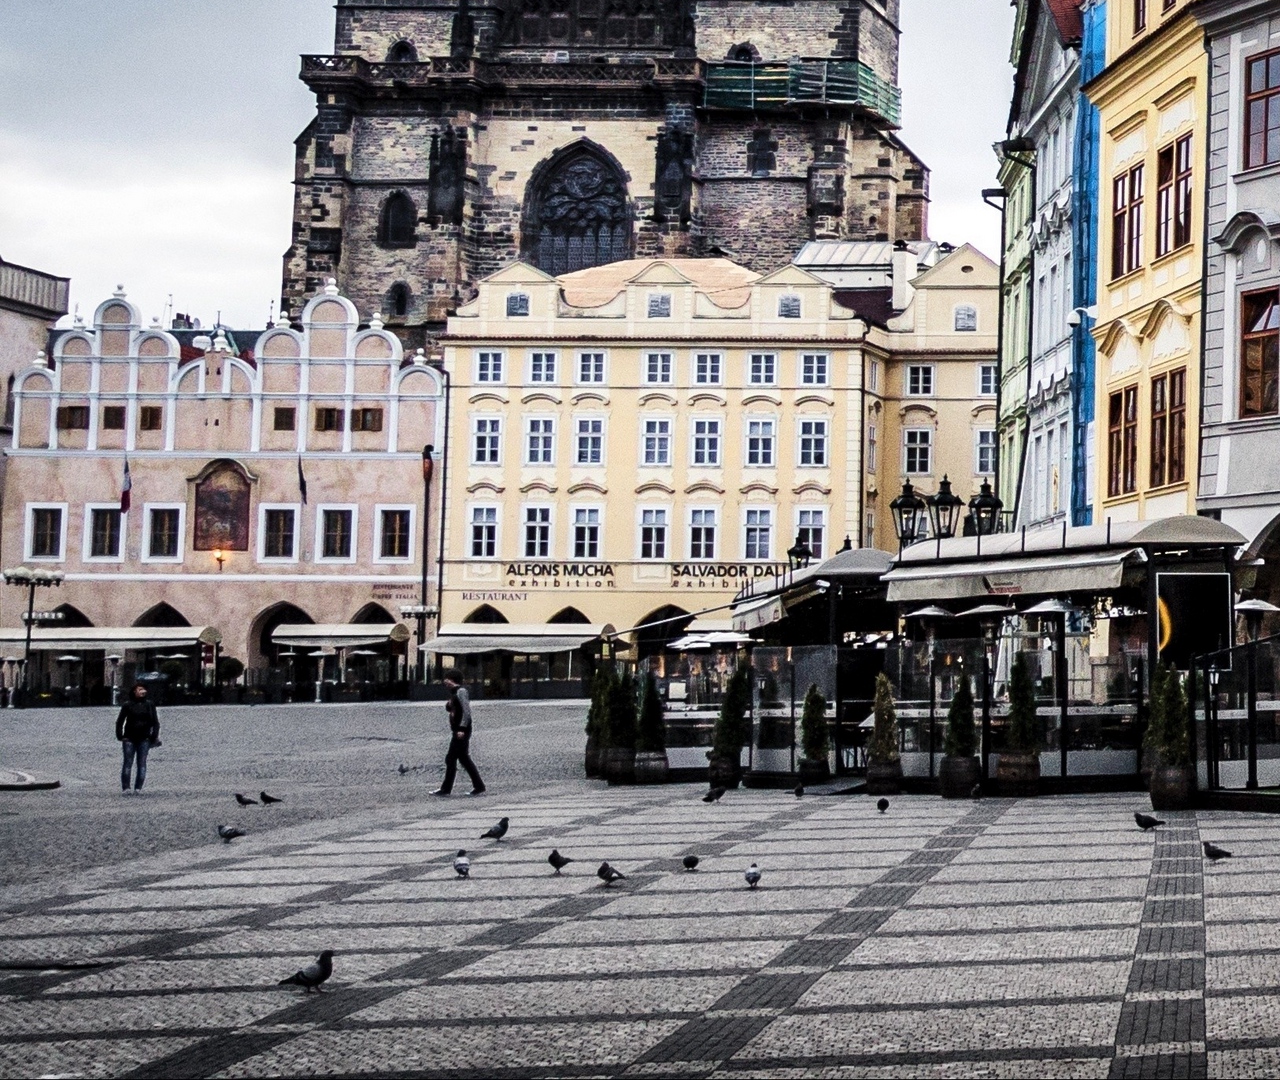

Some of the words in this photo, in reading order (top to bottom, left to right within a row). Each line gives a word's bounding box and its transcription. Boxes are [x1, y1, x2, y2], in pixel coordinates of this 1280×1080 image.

[506, 563, 560, 576] ALFONS
[563, 564, 614, 577] MUCHA
[672, 564, 748, 578] SALVADOR
[508, 577, 615, 588] exhibition
[462, 592, 527, 601] RESTAURANT
